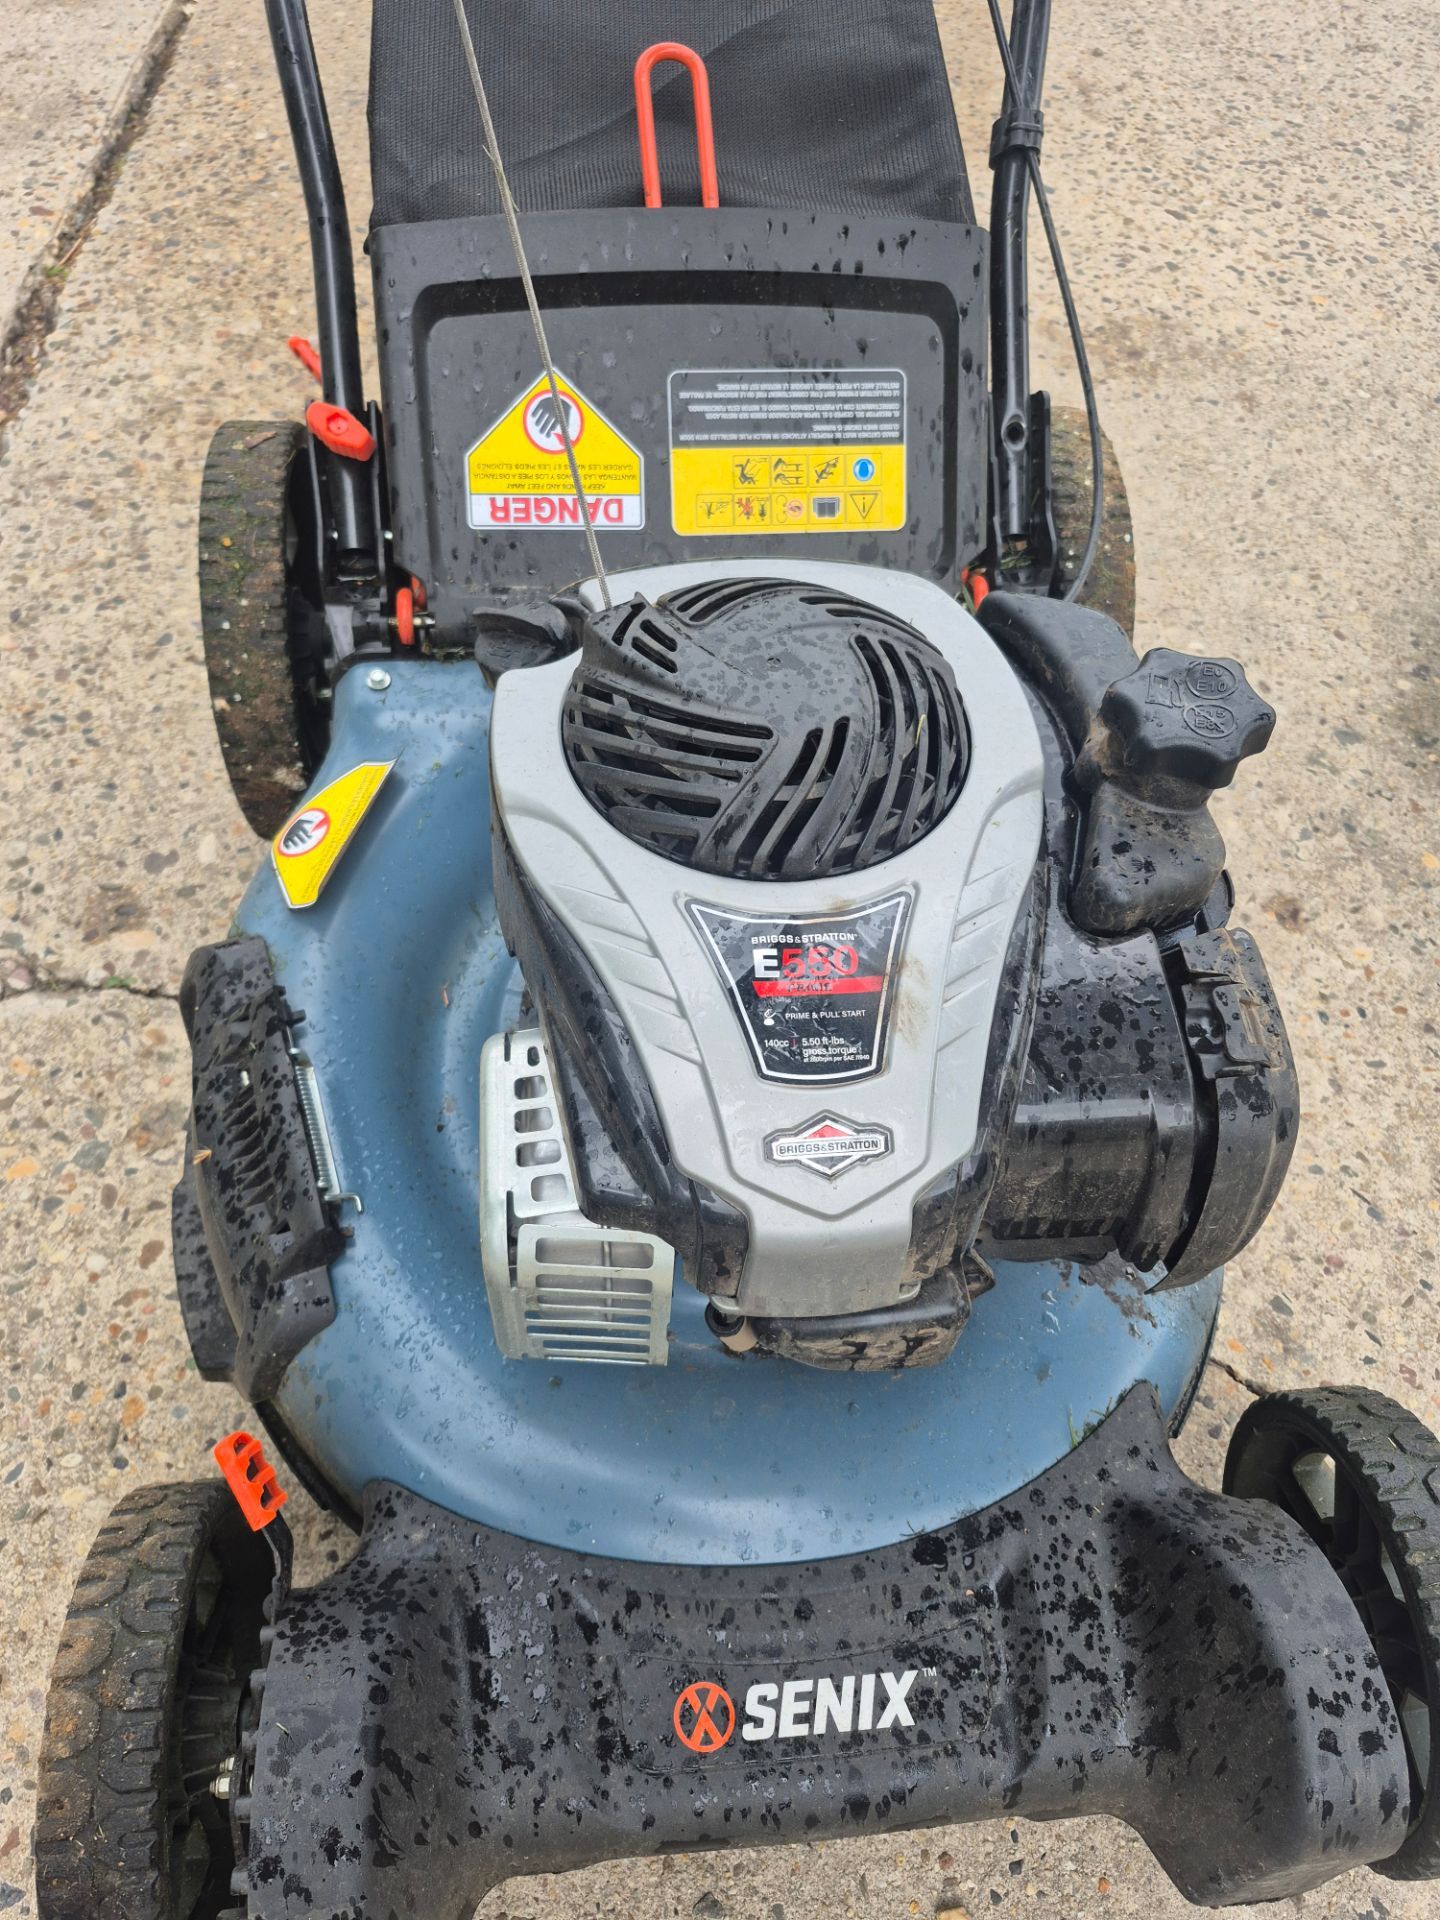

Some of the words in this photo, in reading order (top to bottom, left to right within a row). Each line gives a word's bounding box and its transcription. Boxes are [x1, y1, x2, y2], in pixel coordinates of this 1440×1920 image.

[489, 497, 623, 524] DANGER
[1203, 664, 1224, 677] E0
[1196, 680, 1228, 692] E10
[752, 945, 859, 979] E550
[785, 1012, 811, 1020] PRIME
[841, 1010, 866, 1018] START
[802, 1037, 820, 1046] 5.50
[821, 1036, 845, 1045] ft-lbs
[802, 1048, 827, 1057] gross
[828, 1046, 857, 1055] torque
[778, 1139, 879, 1155] BRIGGS&STRATTON
[742, 1670, 918, 1741] SENIX
